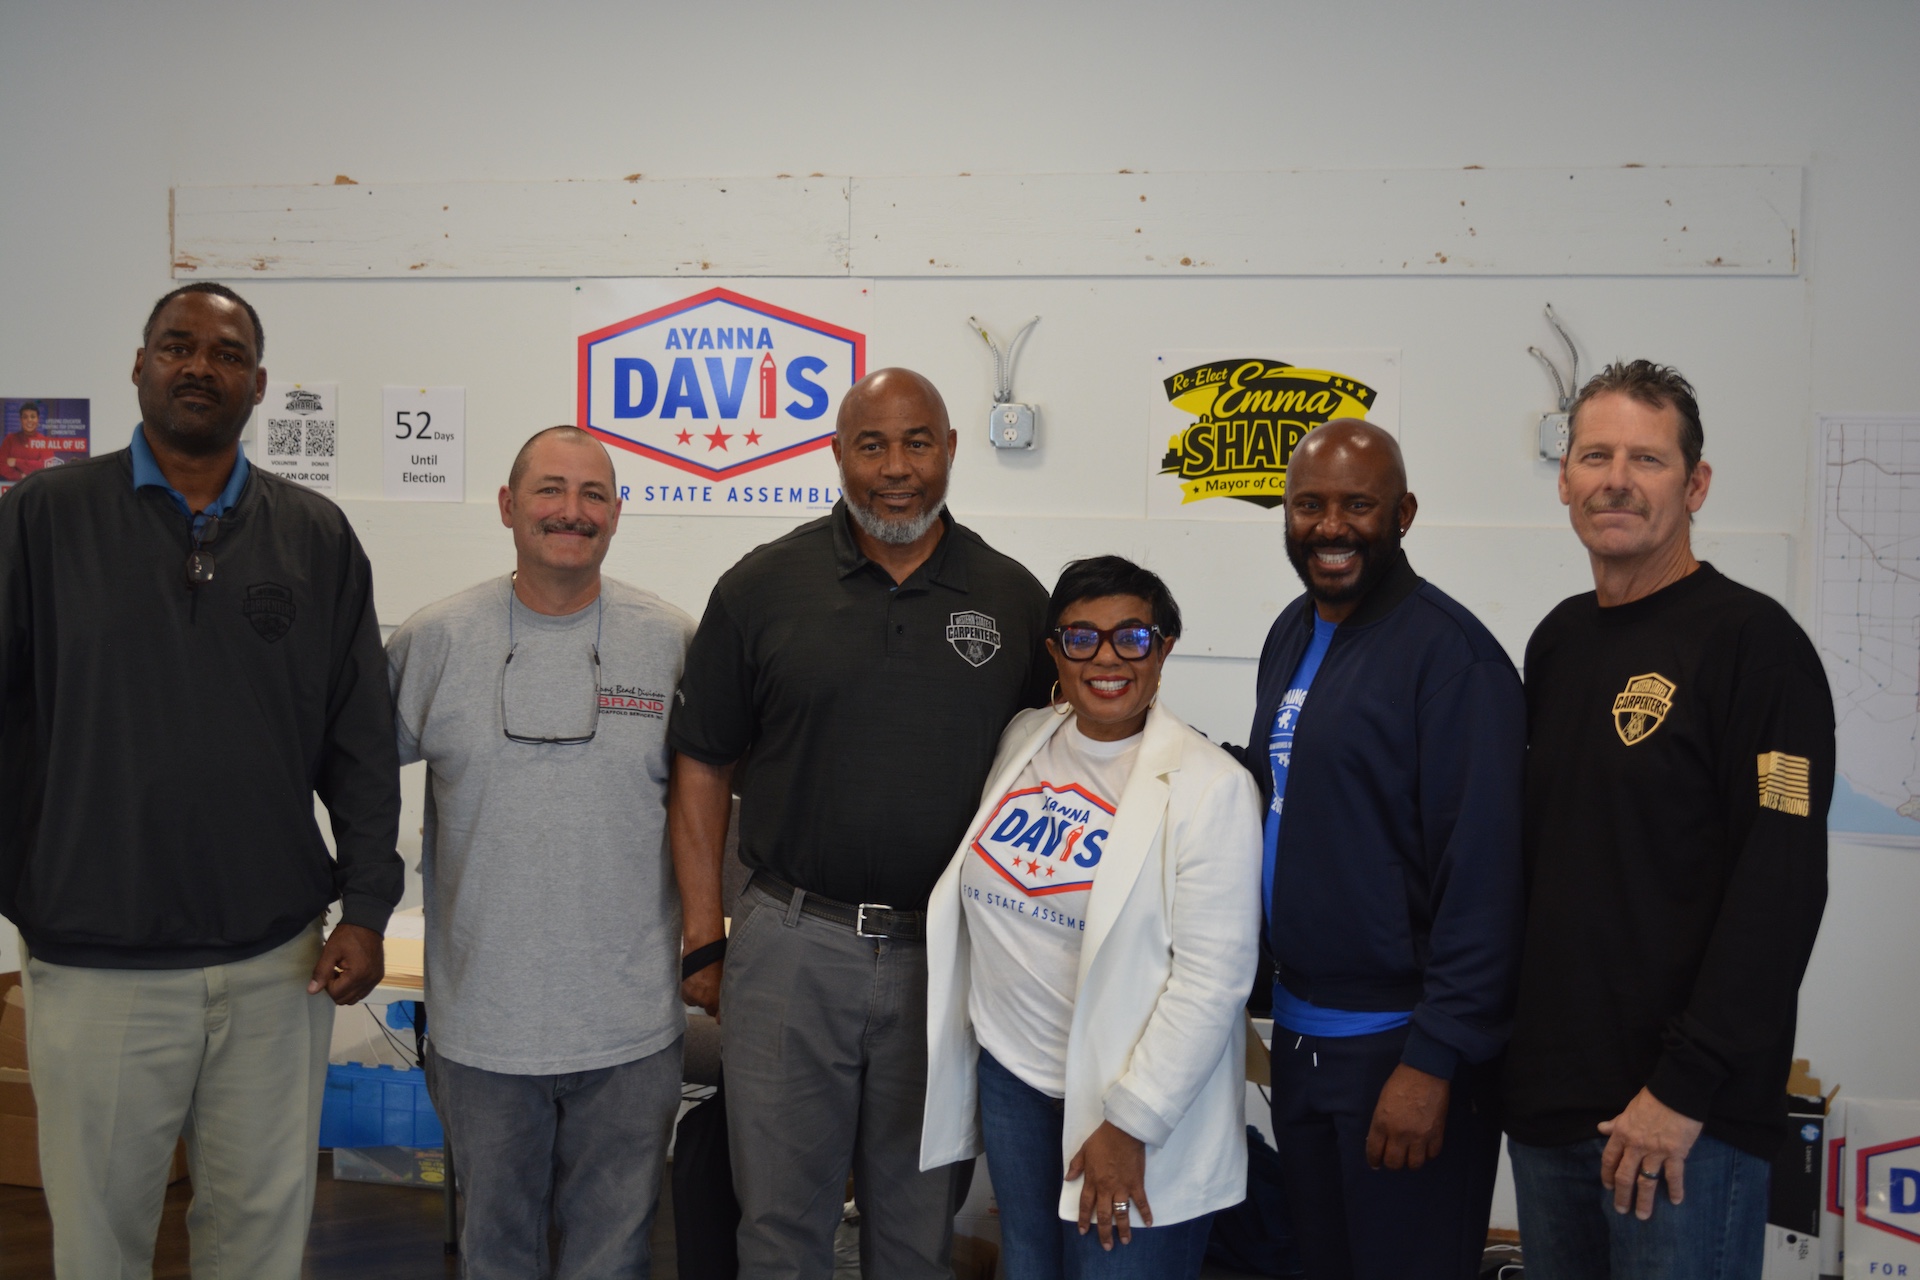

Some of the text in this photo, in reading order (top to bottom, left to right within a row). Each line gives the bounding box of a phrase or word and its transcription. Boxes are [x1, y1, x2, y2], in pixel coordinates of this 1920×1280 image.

[665, 327, 774, 350] AYANNA
[614, 352, 829, 420] DAVIS
[1172, 368, 1228, 393] Re-Elect
[1213, 361, 1338, 418] Emma
[395, 411, 455, 442] 52 Days
[31, 439, 85, 449] FOR ALL OF US
[1182, 420, 1321, 476] SHAR
[411, 455, 438, 465] Until
[275, 472, 330, 481] CAN QR CODE
[402, 472, 446, 483] Election
[1205, 479, 1250, 493] Mayor
[1253, 477, 1267, 488] of
[645, 486, 712, 502] STATE
[948, 626, 1000, 646] CARPENTERS
[597, 696, 664, 711] BRAND
[1615, 695, 1668, 717] CARPENTERS
[1778, 795, 1809, 817] STRONG
[990, 808, 1109, 868] DAVIS
[987, 893, 1025, 913] STATE
[1031, 906, 1085, 931] ASSEMB
[1870, 1262, 1908, 1277] FOR
